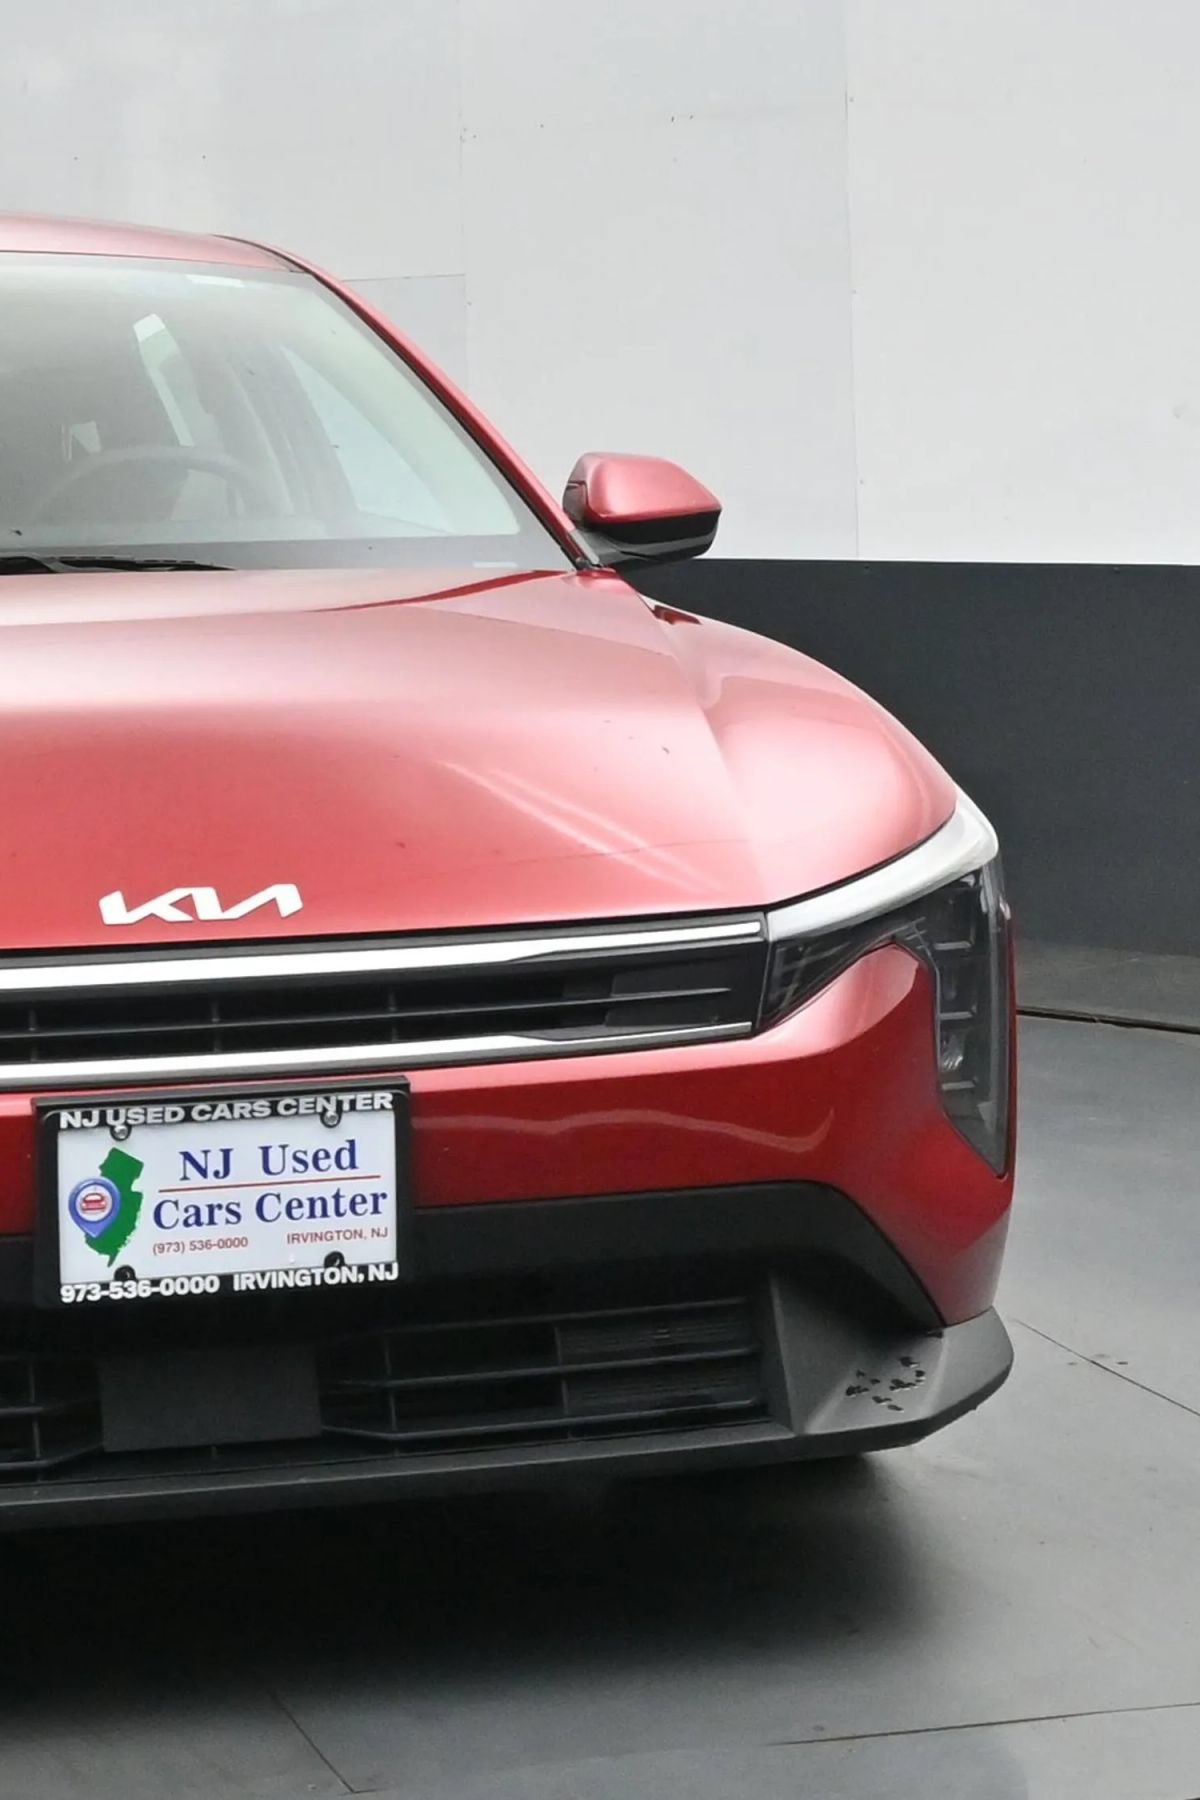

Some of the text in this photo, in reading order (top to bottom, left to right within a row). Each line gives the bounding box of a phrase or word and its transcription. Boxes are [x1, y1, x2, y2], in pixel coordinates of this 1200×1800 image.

[59, 1092, 394, 1130] NJ USED CARS CENTER
[179, 1139, 359, 1181] NJ Used
[153, 1188, 388, 1230] Cars Center
[152, 1236, 248, 1256] (973) 536-0000
[287, 1227, 389, 1245] IRVINGTON, NJ
[60, 1261, 399, 1304] 973-536-0000 IRVINGTON, NJ
